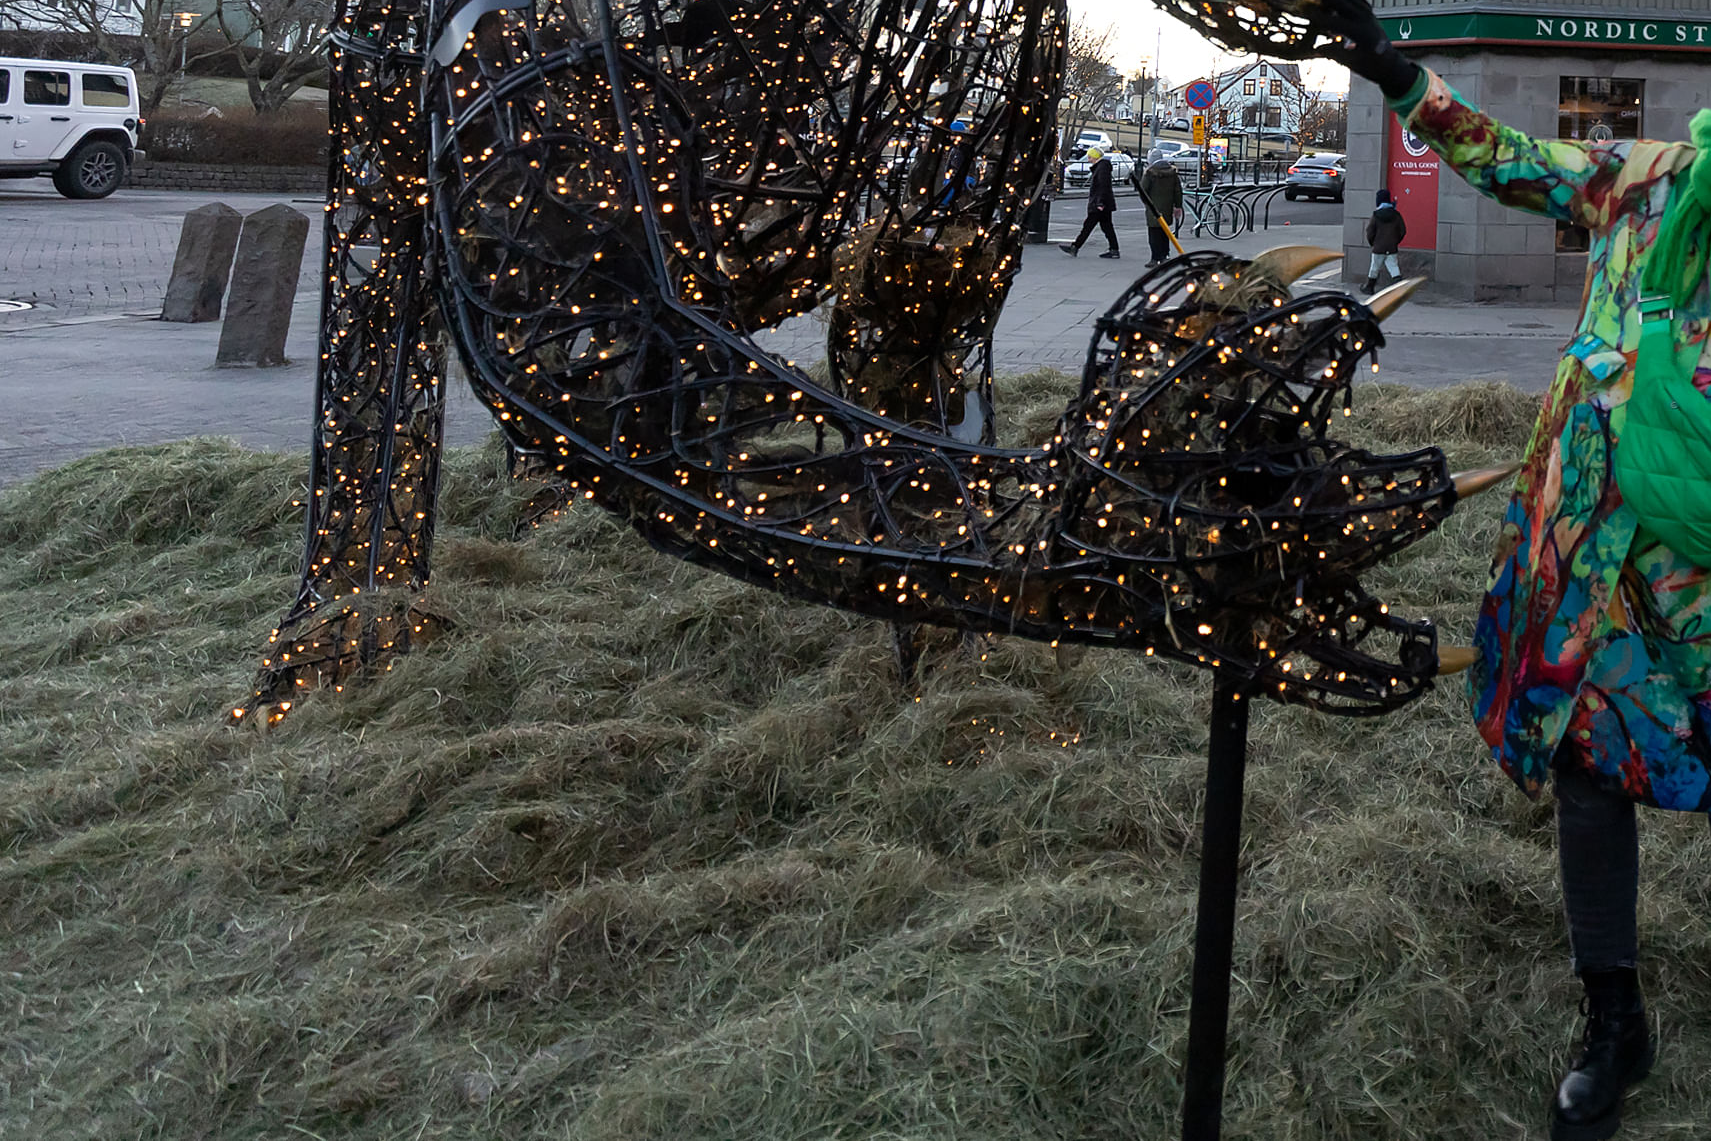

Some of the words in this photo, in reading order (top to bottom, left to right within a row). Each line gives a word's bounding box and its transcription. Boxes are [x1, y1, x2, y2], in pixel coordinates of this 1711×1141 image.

[1535, 19, 1658, 40] NORDIC
[1393, 161, 1418, 169] CANADA
[1418, 161, 1440, 170] GOOSE
